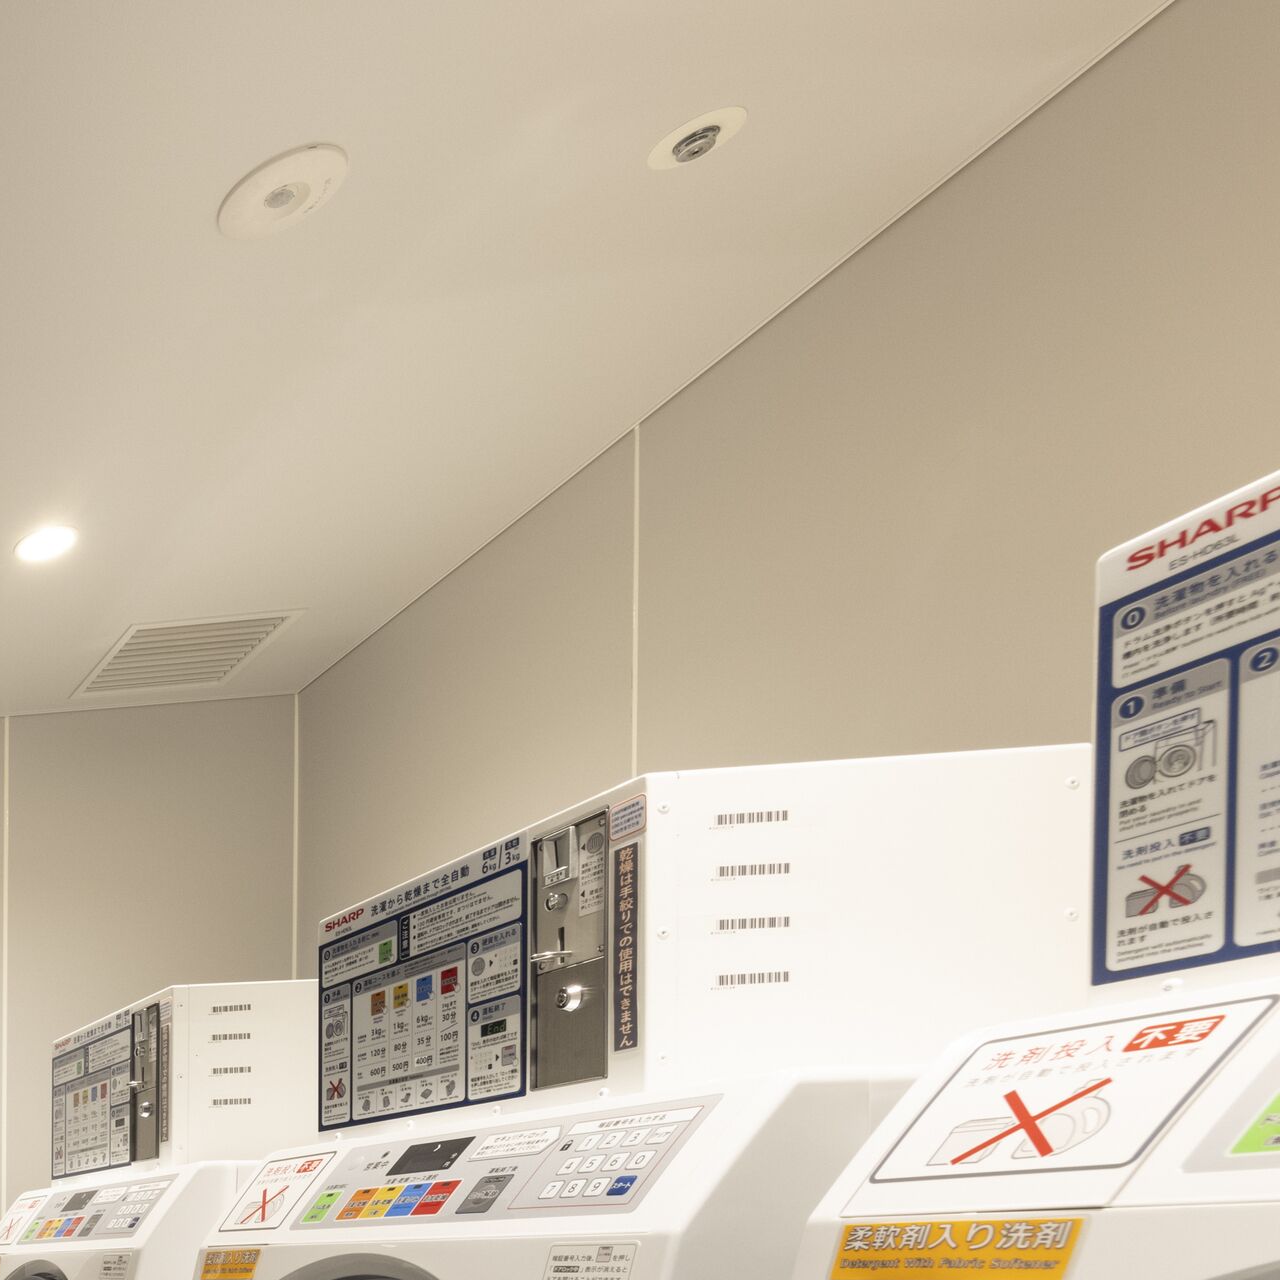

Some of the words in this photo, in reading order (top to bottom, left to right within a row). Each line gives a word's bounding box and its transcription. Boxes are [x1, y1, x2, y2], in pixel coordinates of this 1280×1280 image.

[370, 863, 469, 917] 洗濯から乾燥まで全自動
[325, 907, 363, 933] SHARP
[618, 847, 634, 1047] 乾燥は手絞りでの使用はできません
[984, 1036, 1118, 1070] 洗剤投入
[1133, 1019, 1213, 1048] 不要
[844, 1221, 1072, 1250] 柔軟剤入り洗剤
[841, 1258, 899, 1270] Detergent
[905, 1257, 934, 1268] With
[939, 1257, 984, 1268] Fabric
[990, 1258, 1059, 1269] Softener
